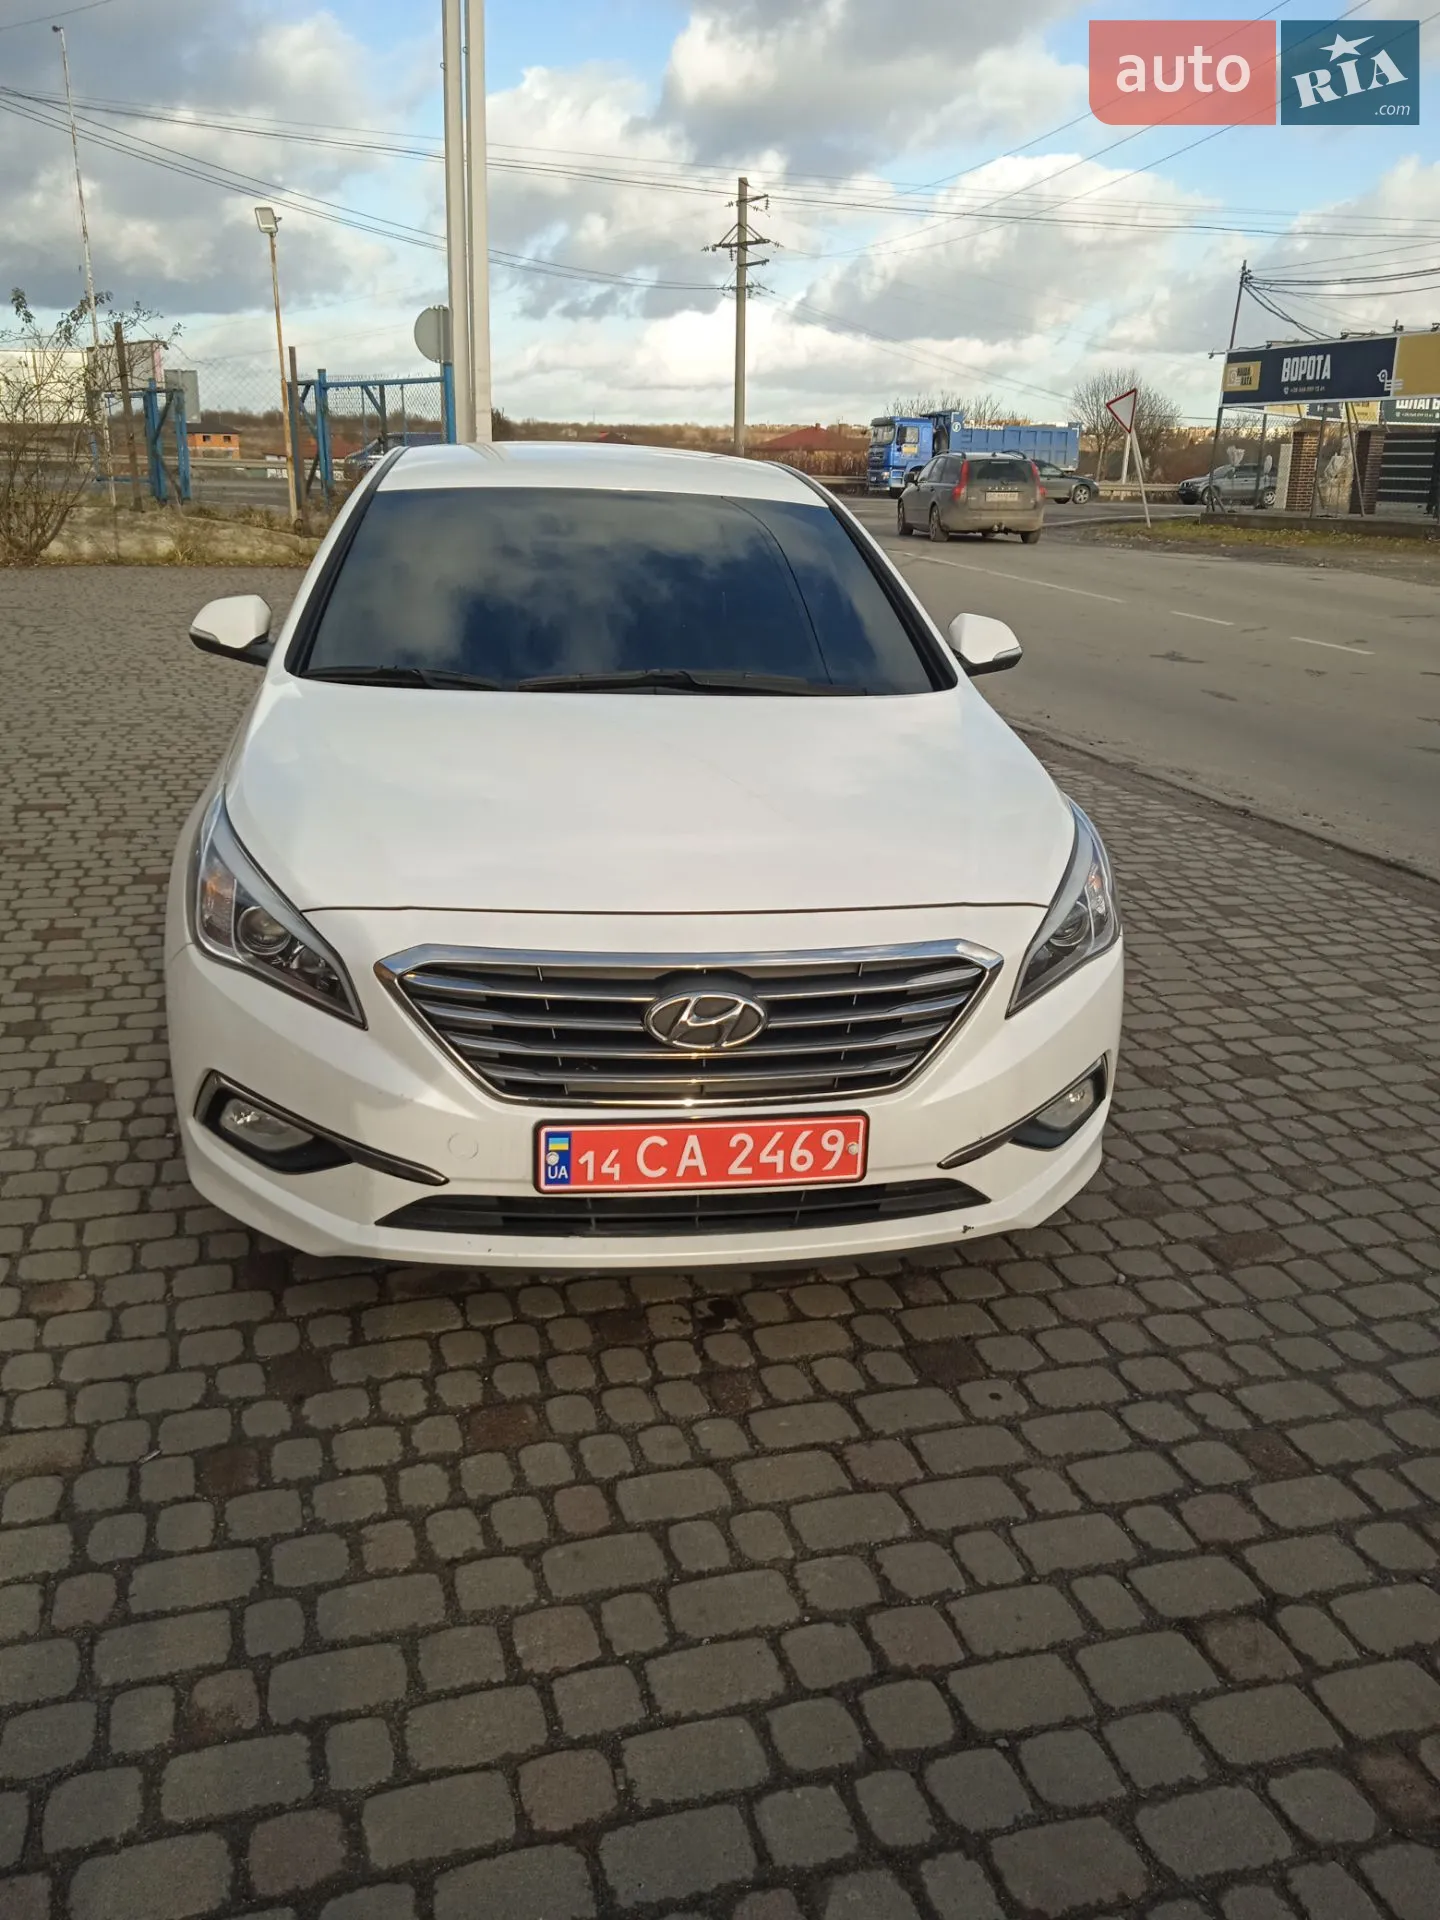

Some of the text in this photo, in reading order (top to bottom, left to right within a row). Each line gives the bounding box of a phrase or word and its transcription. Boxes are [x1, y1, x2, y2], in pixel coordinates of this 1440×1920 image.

[1281, 354, 1331, 382] ВОРОТА
[578, 1149, 621, 1181] 14
[727, 1128, 845, 1176] 2469
[547, 1165, 569, 1180] UA
